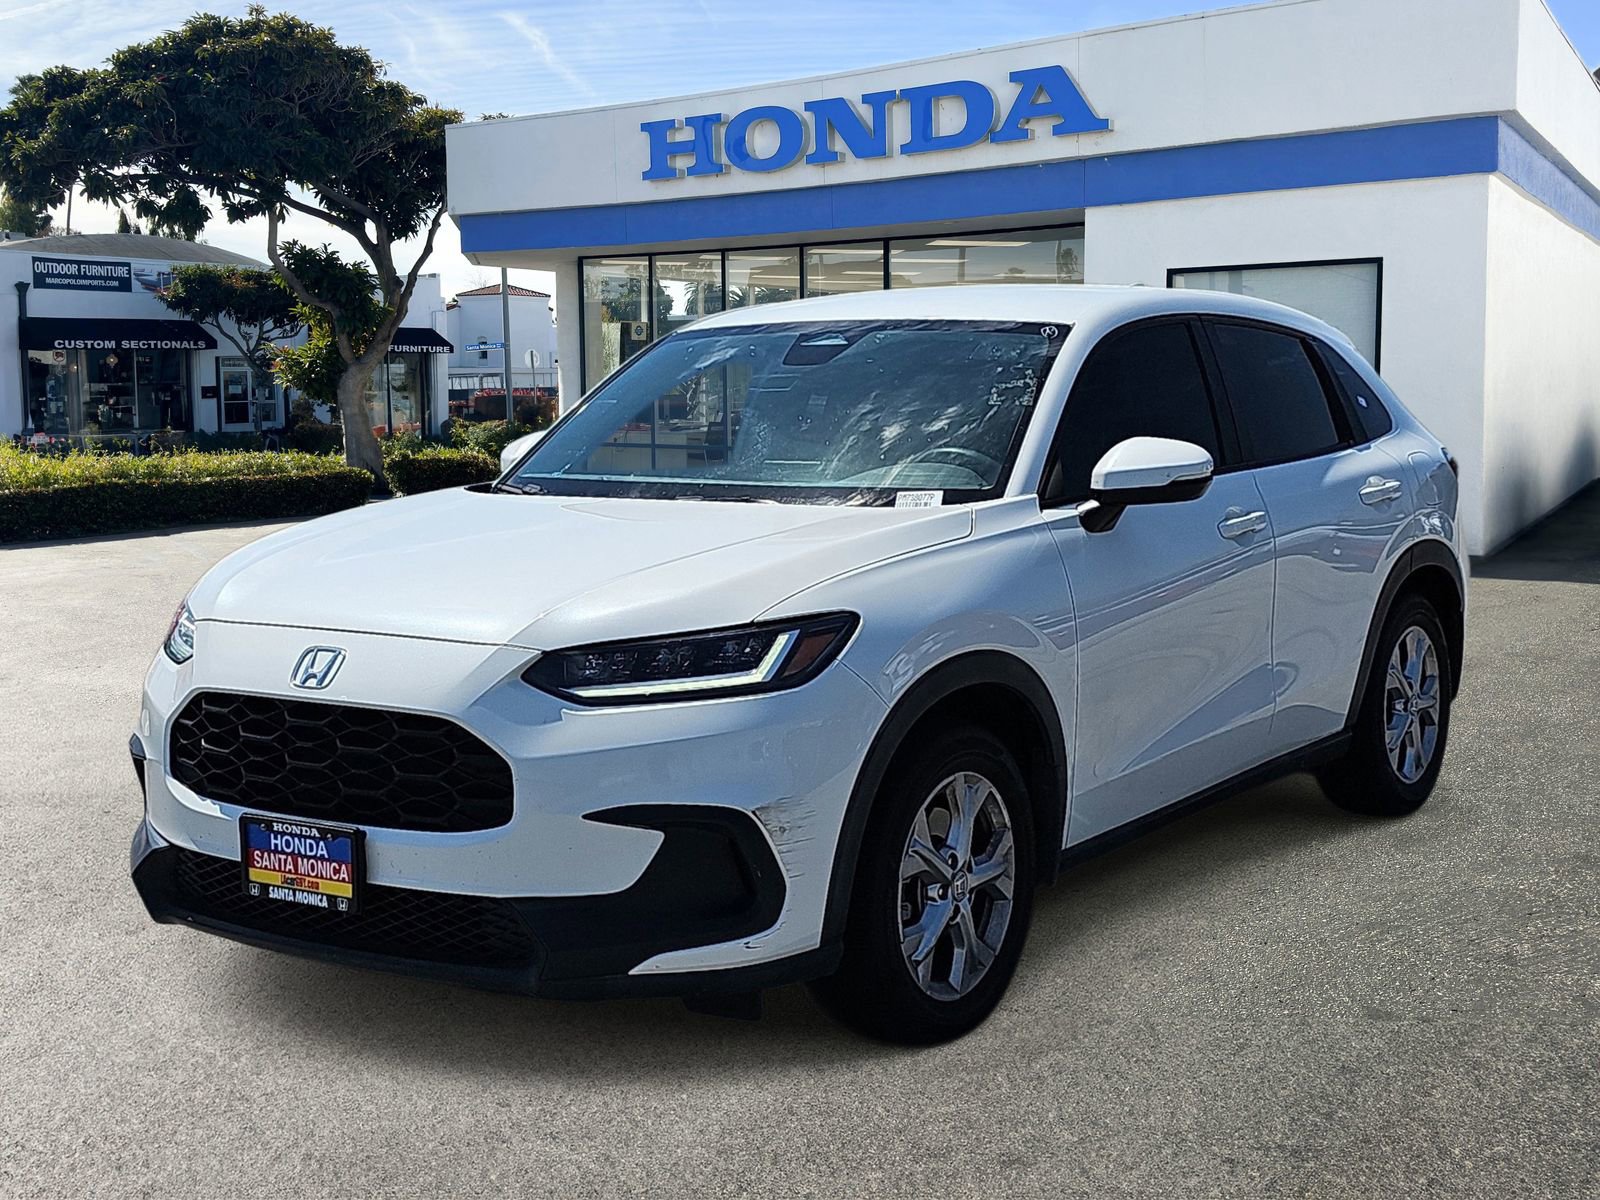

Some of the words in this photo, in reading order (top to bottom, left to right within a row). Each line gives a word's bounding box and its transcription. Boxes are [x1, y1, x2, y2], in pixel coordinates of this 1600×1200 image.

[640, 64, 1113, 181] HONDA
[34, 261, 78, 275] OUTDOOR
[81, 264, 130, 278] FURNITURE
[45, 277, 119, 287] MARCOPOLOIMPORTS.COM
[54, 339, 116, 349] CUSTOM
[121, 340, 206, 349] SECTIONALS
[388, 344, 450, 353] FURNITURE
[272, 822, 320, 837] HONDA
[270, 833, 328, 858] HONDA
[254, 850, 295, 873] SANTA
[298, 856, 349, 881] MONICA
[268, 886, 294, 902] SANTA
[295, 890, 329, 908] MONICA
